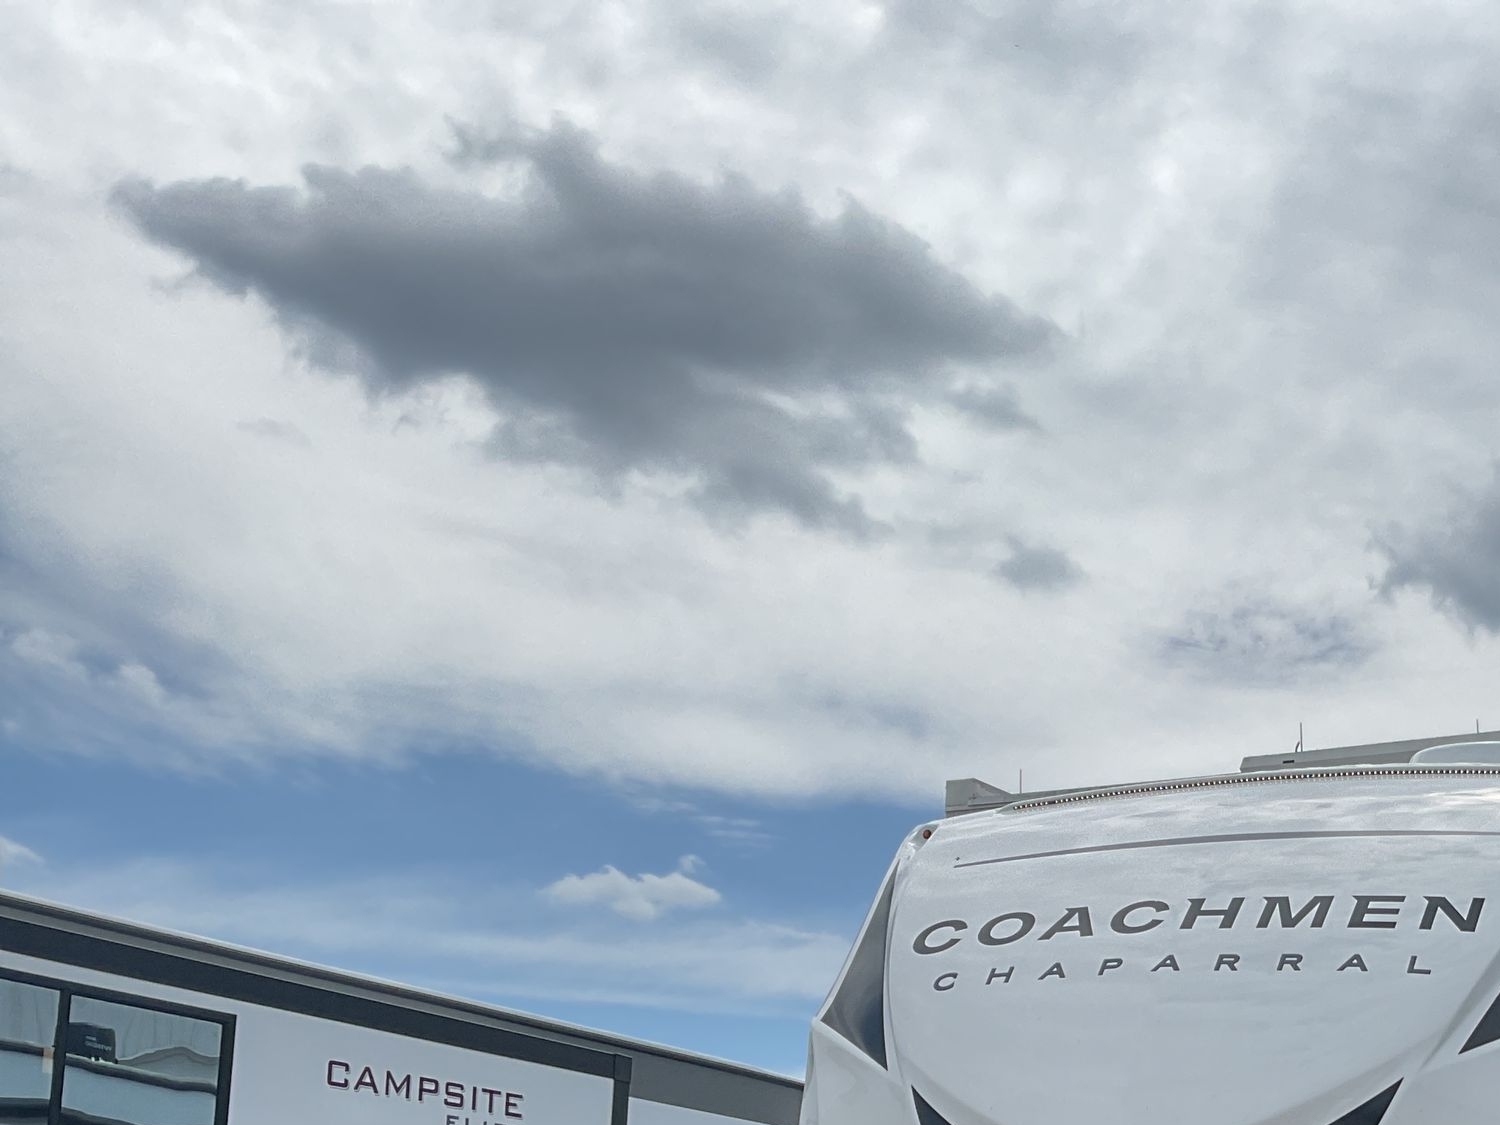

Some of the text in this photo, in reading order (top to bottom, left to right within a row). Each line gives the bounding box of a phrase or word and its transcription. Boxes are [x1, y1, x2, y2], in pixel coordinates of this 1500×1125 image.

[911, 895, 1486, 955] COACHMEN
[932, 953, 1433, 992] CHAPARRAL
[327, 1060, 524, 1119] CAMPSITE
